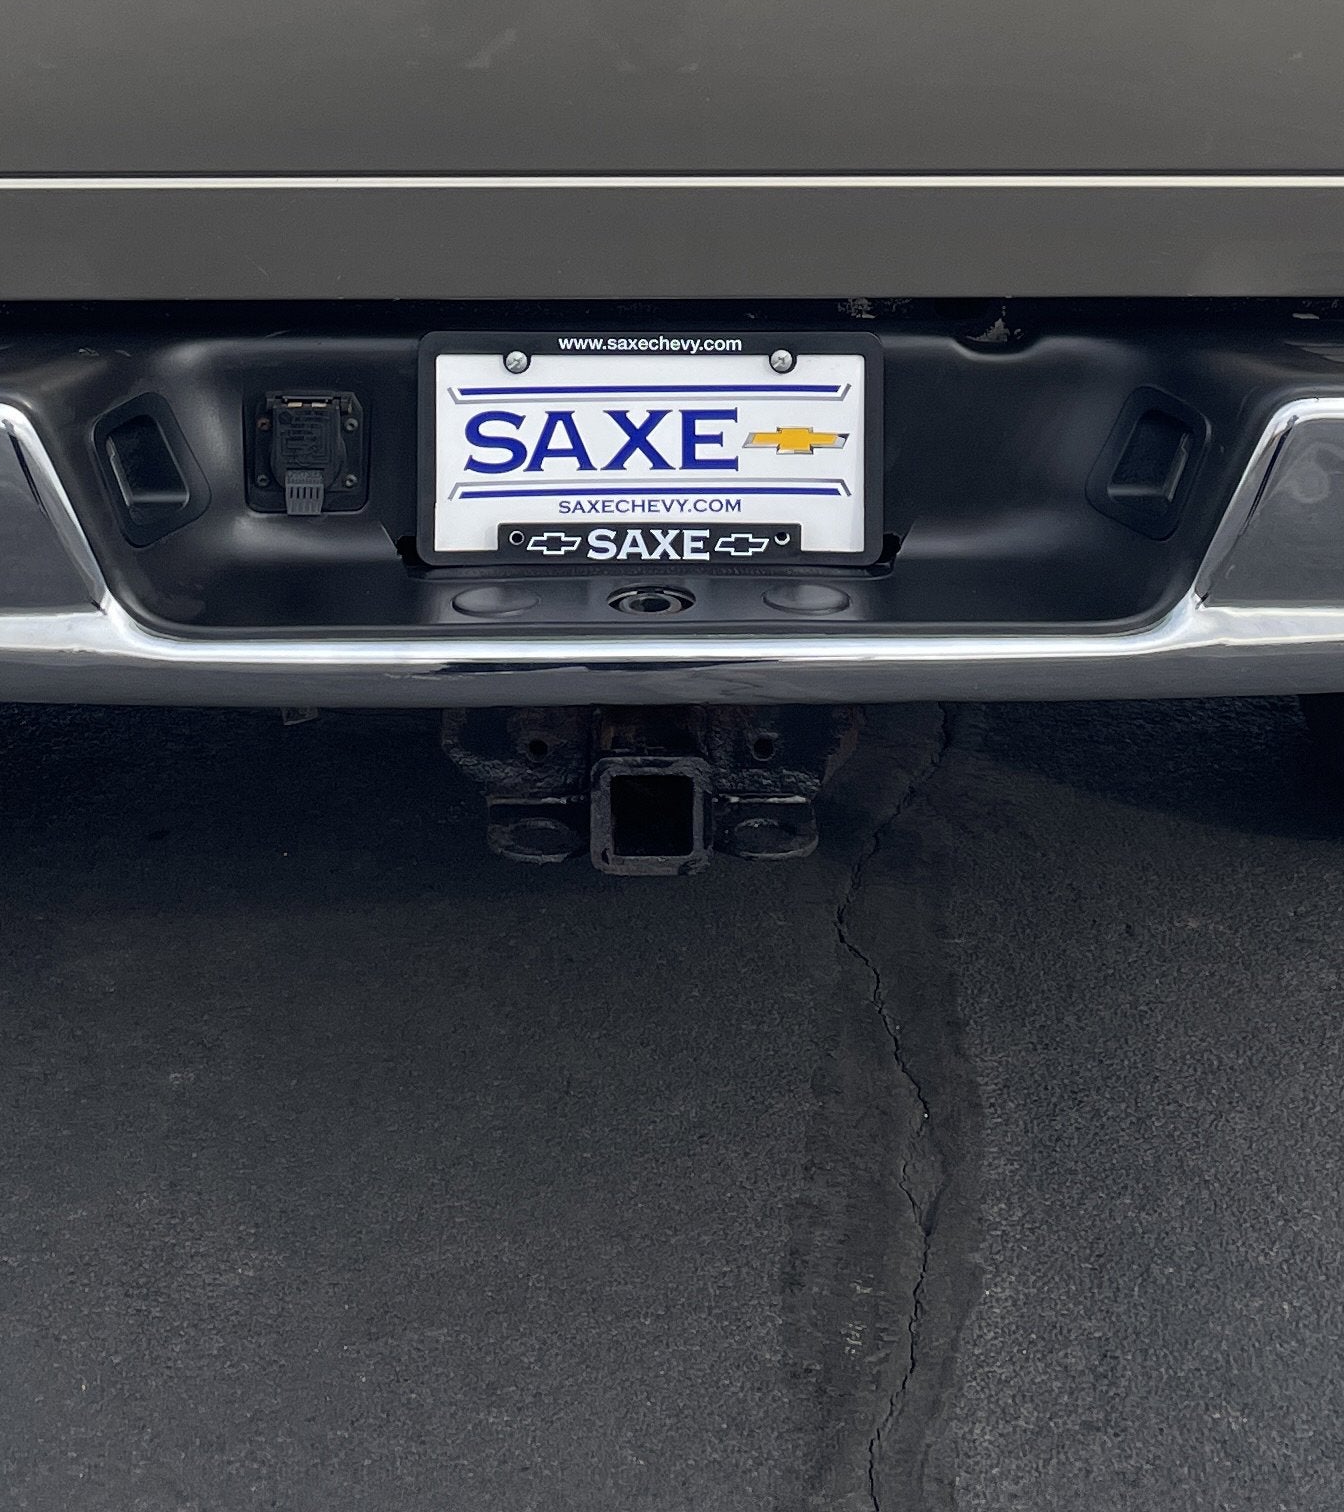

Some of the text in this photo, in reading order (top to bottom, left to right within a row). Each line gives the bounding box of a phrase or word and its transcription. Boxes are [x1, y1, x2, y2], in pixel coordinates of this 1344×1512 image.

[558, 336, 742, 354] www.saxechevy.com
[463, 407, 739, 474] SAXE
[558, 498, 742, 514] SAXECHEVY.COM
[586, 528, 711, 561] SAXE
